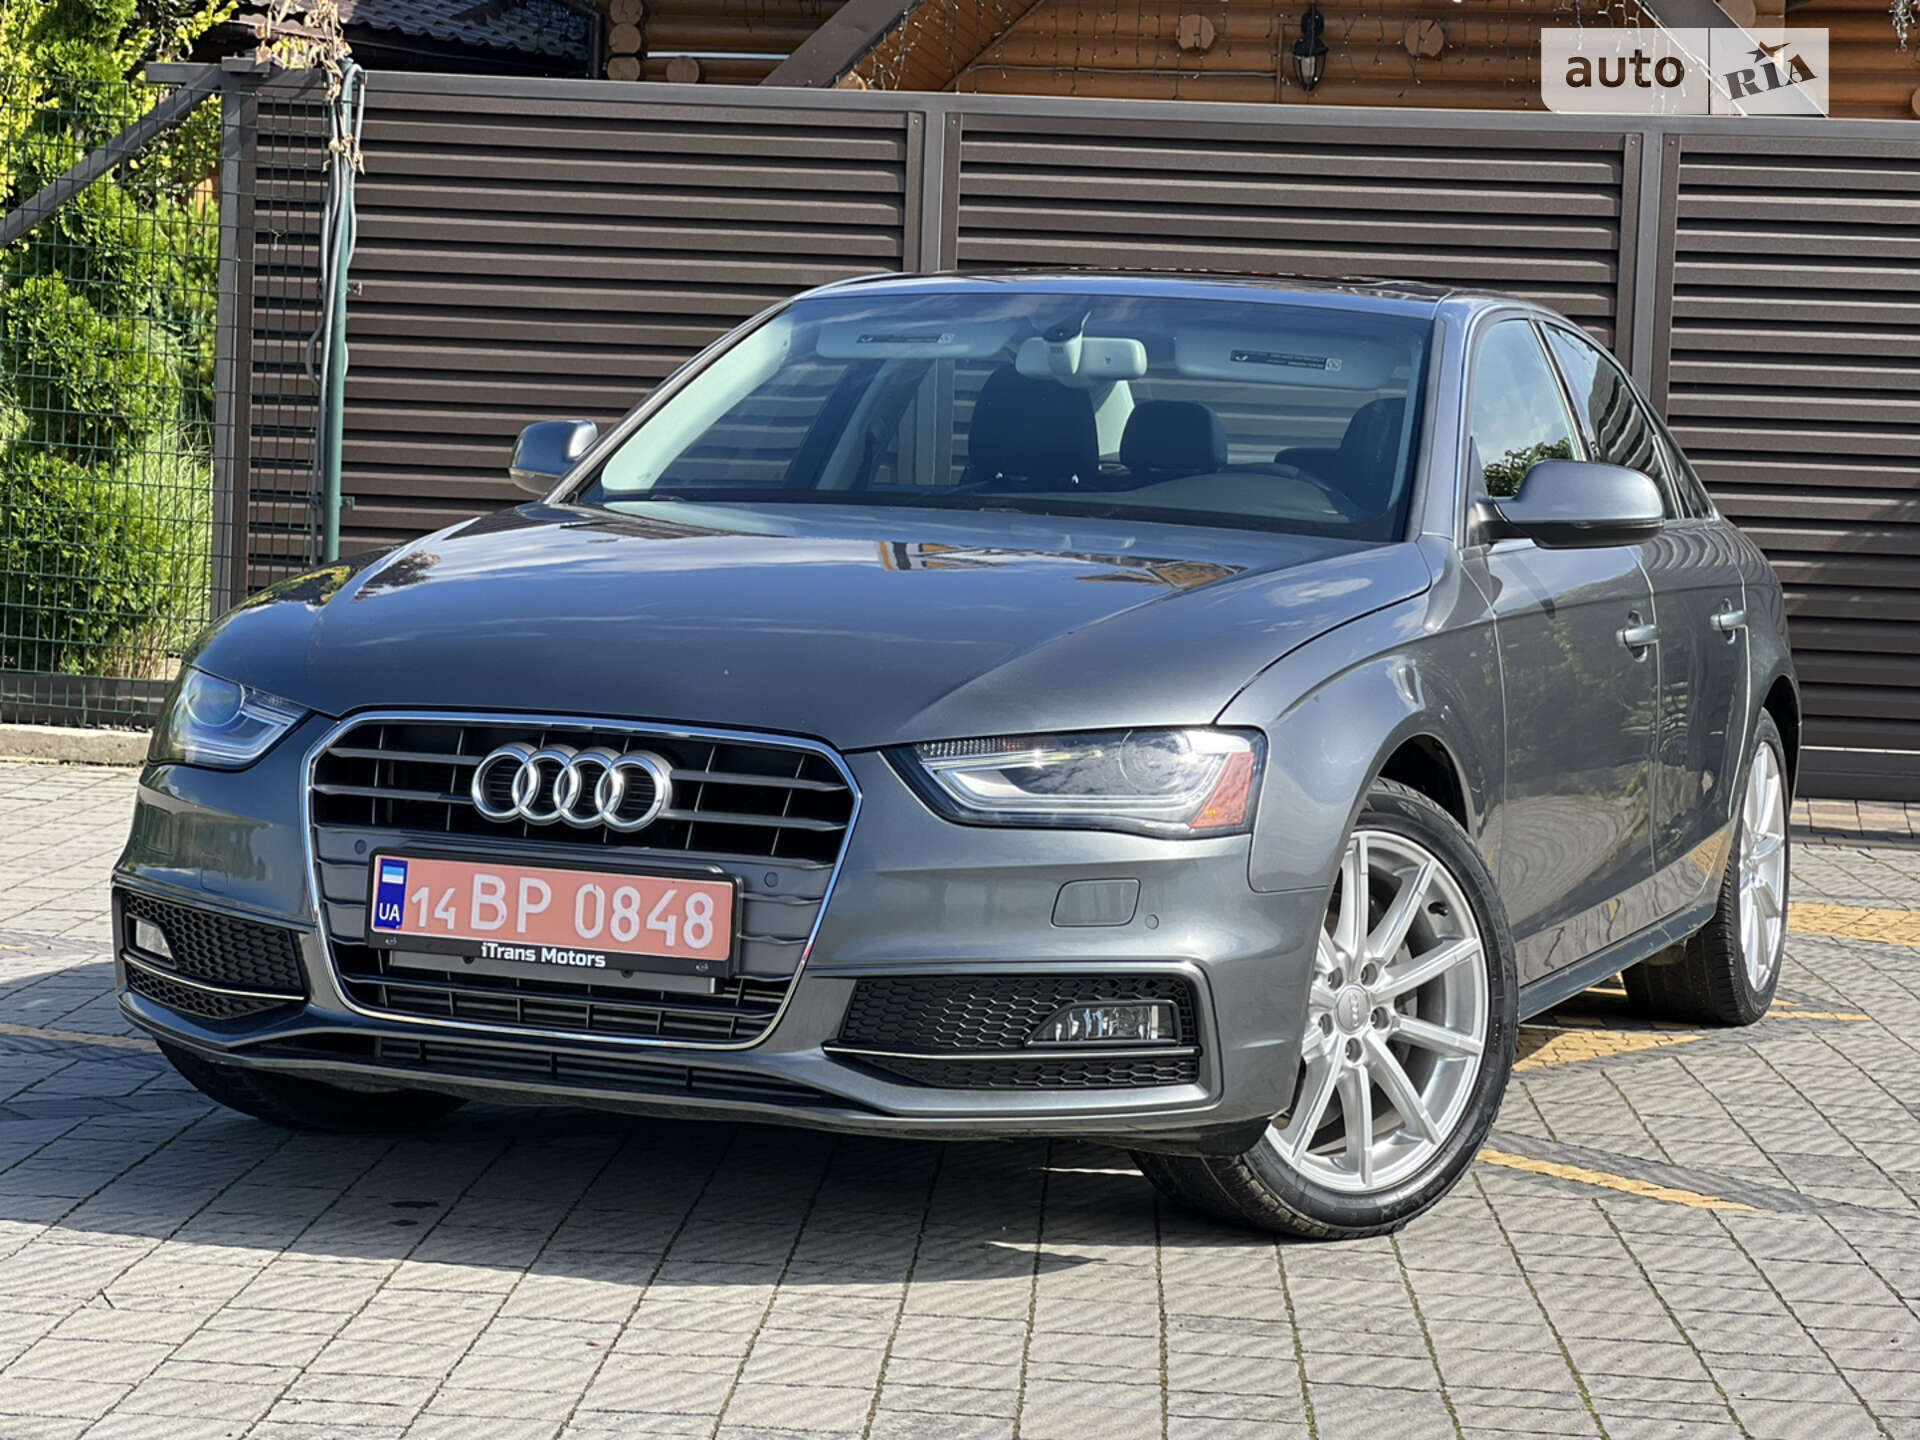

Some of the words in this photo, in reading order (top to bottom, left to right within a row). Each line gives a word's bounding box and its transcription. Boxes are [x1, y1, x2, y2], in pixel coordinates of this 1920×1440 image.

[379, 903, 400, 921] UA
[573, 883, 715, 949] 0848
[481, 942, 536, 962] iTrans
[541, 947, 606, 968] Motors
